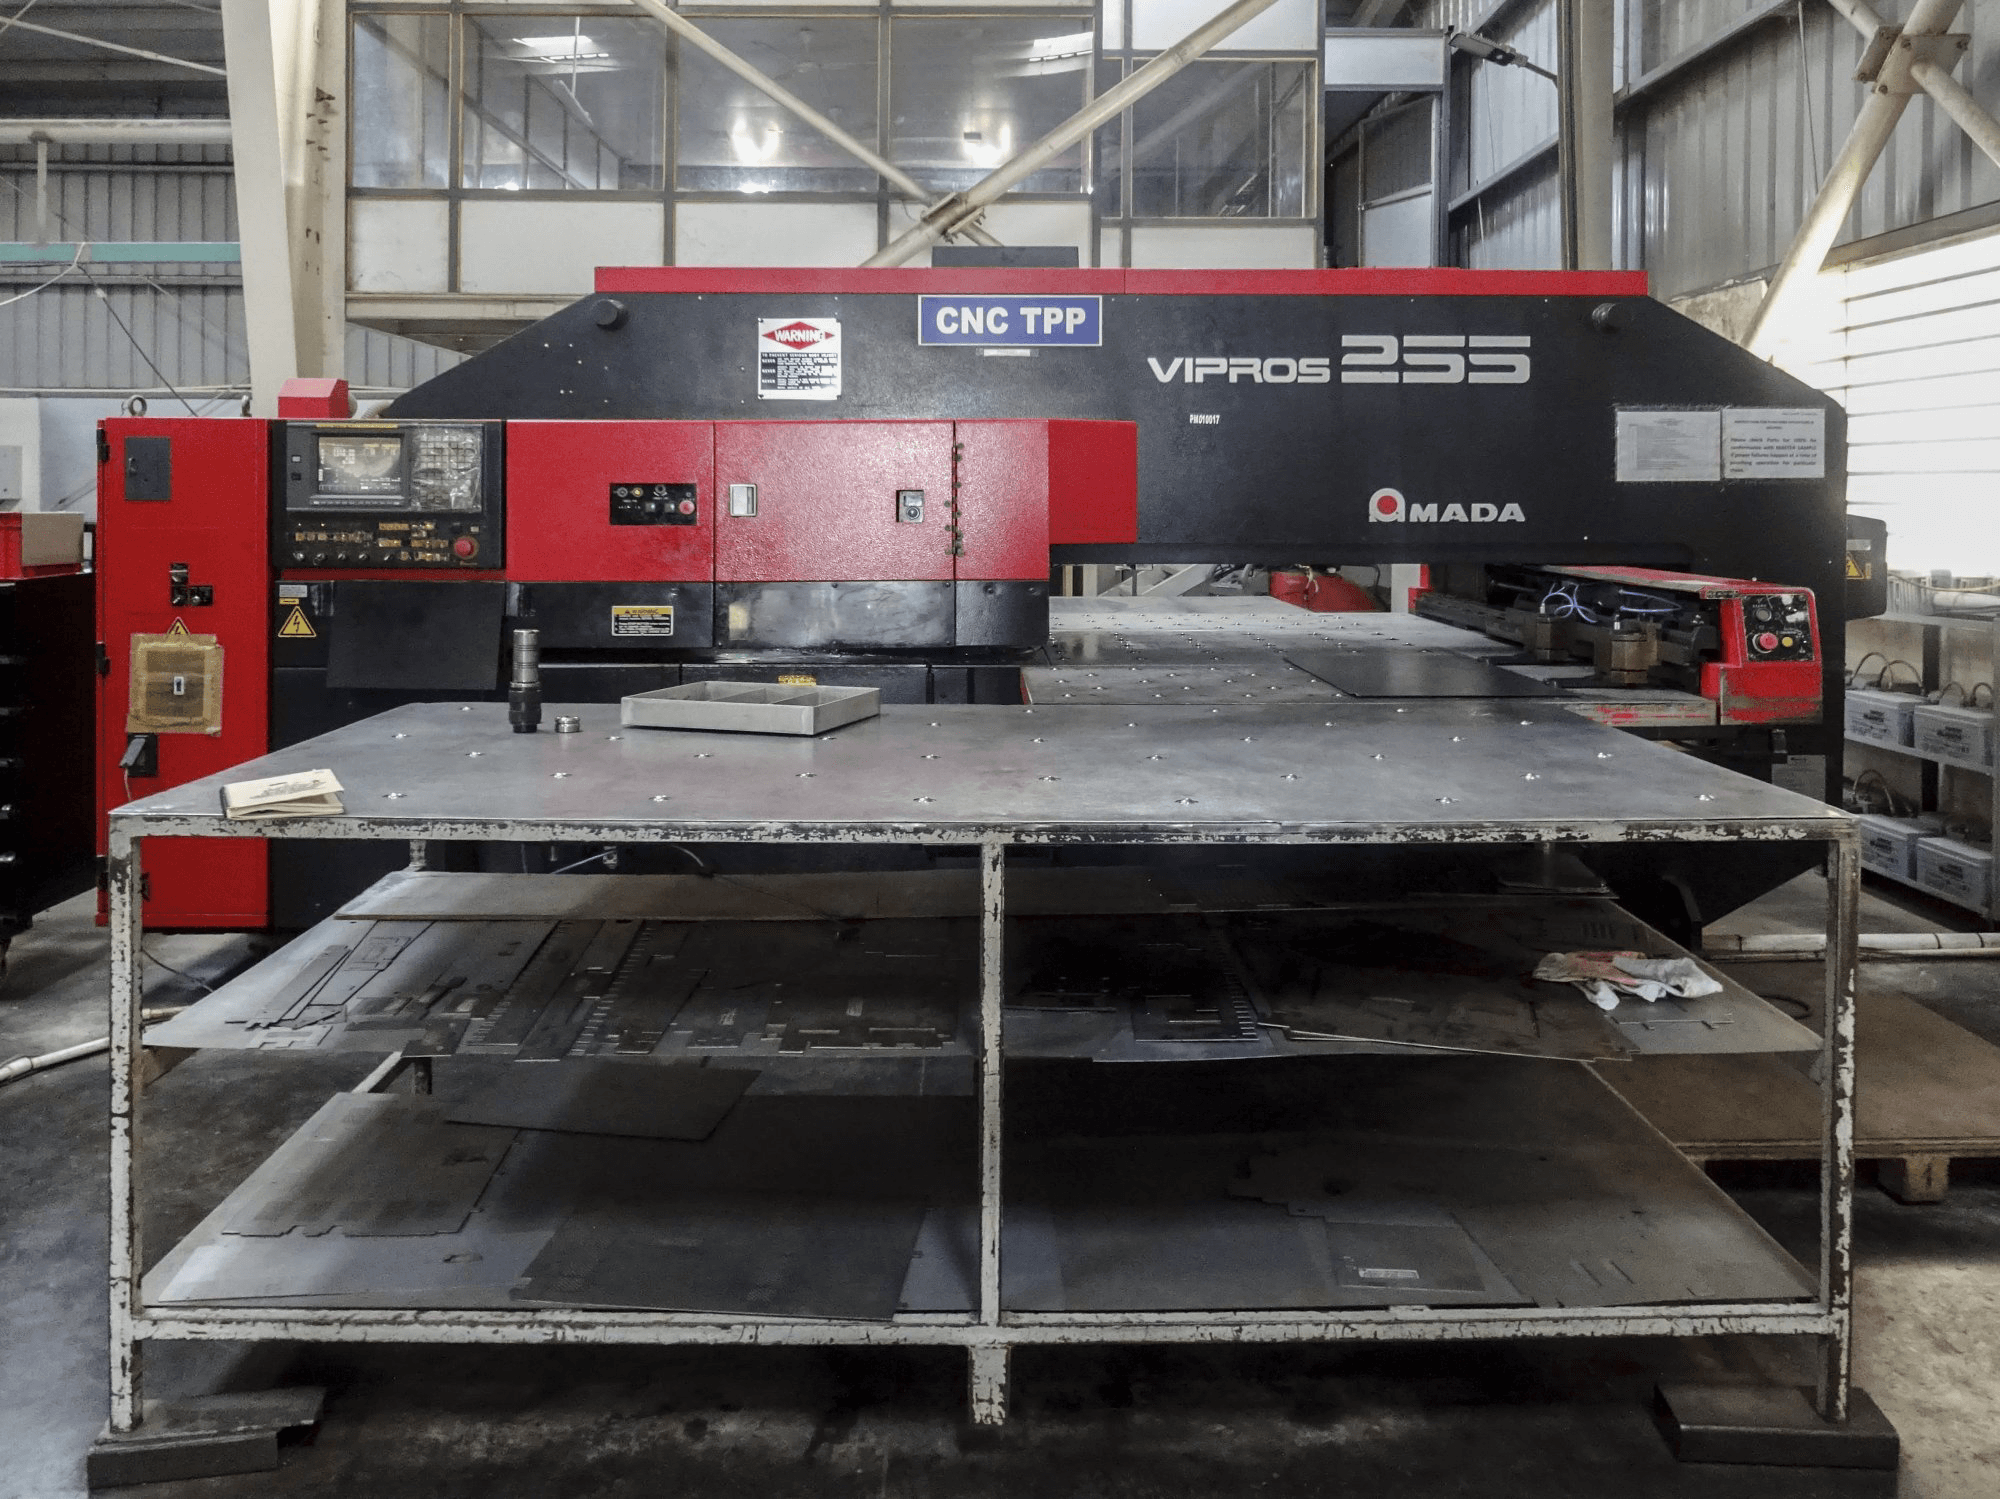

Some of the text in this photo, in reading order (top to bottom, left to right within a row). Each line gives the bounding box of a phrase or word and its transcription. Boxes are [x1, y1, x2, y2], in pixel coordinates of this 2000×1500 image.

[936, 306, 1086, 335] CNC TPP
[1147, 334, 1531, 384] VIPROS 255
